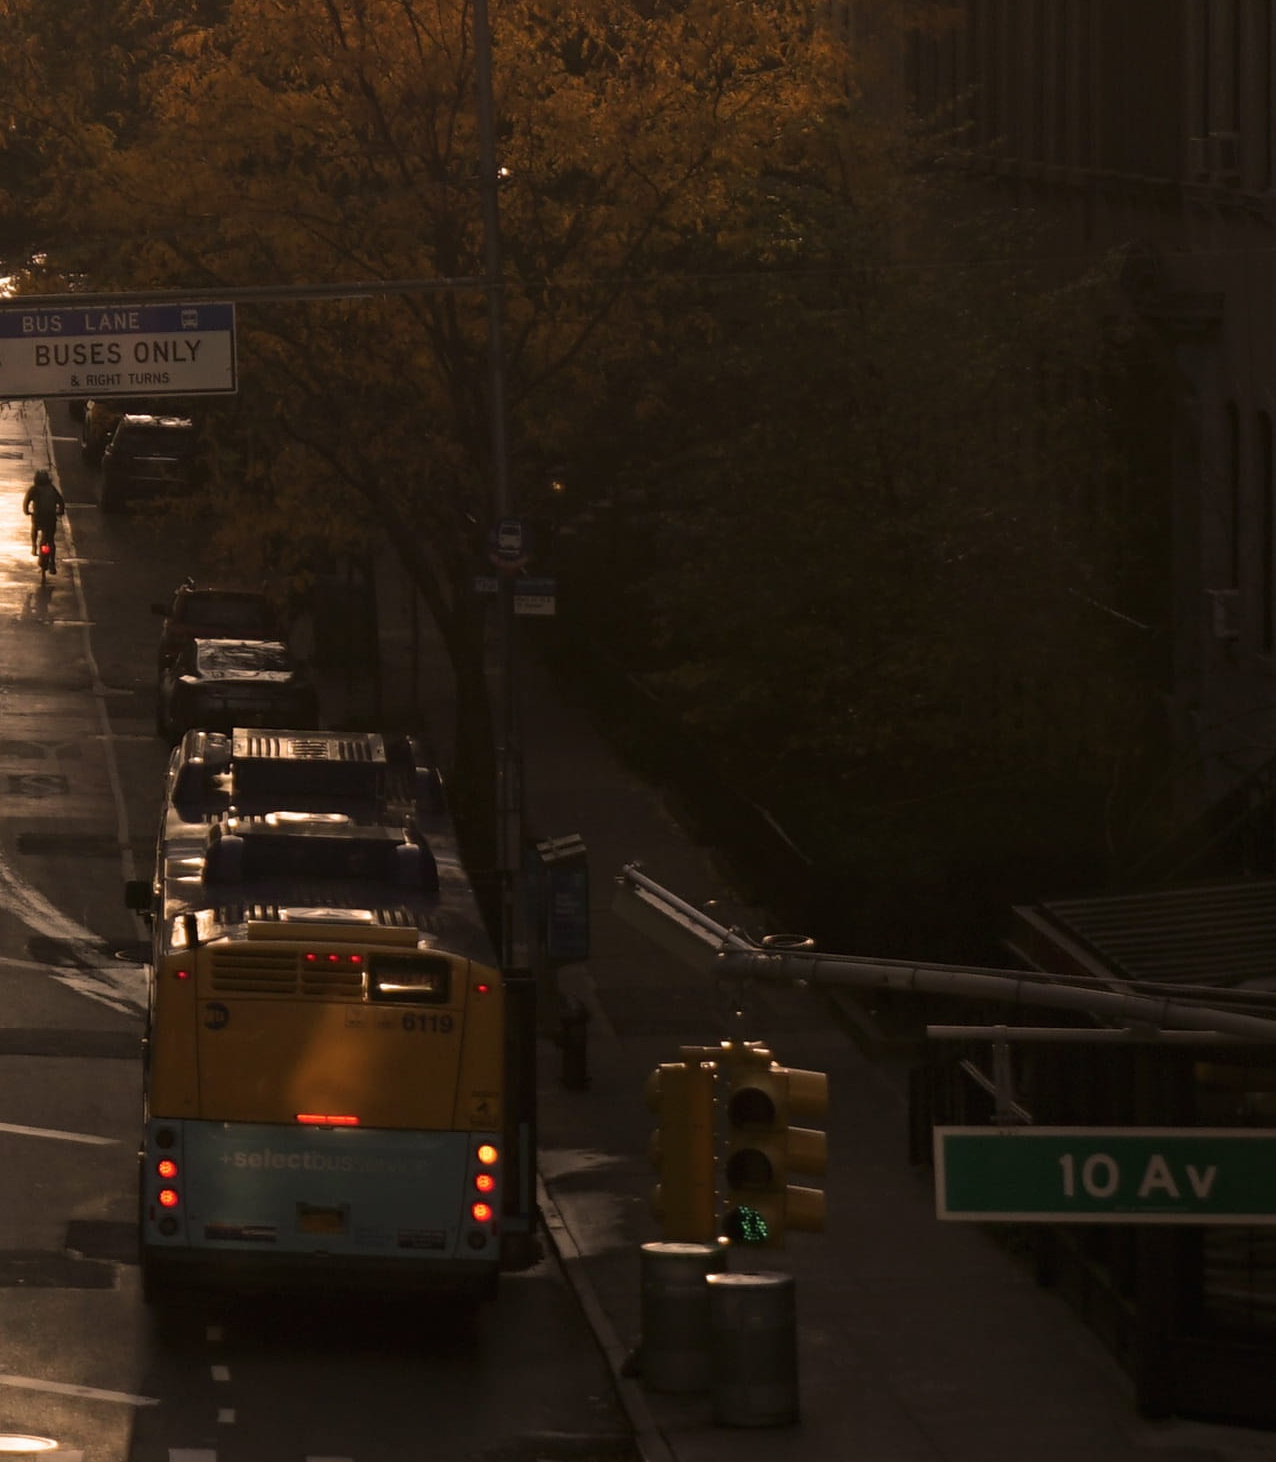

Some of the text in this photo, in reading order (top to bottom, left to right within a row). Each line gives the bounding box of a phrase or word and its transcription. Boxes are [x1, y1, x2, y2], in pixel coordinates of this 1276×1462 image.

[22, 312, 140, 333] BUS LANE
[35, 340, 201, 367] BUSES ONLY
[70, 373, 170, 387] & RIGHT TURNS
[402, 1014, 453, 1034] 6119
[1059, 1152, 1218, 1199] 10 Av
